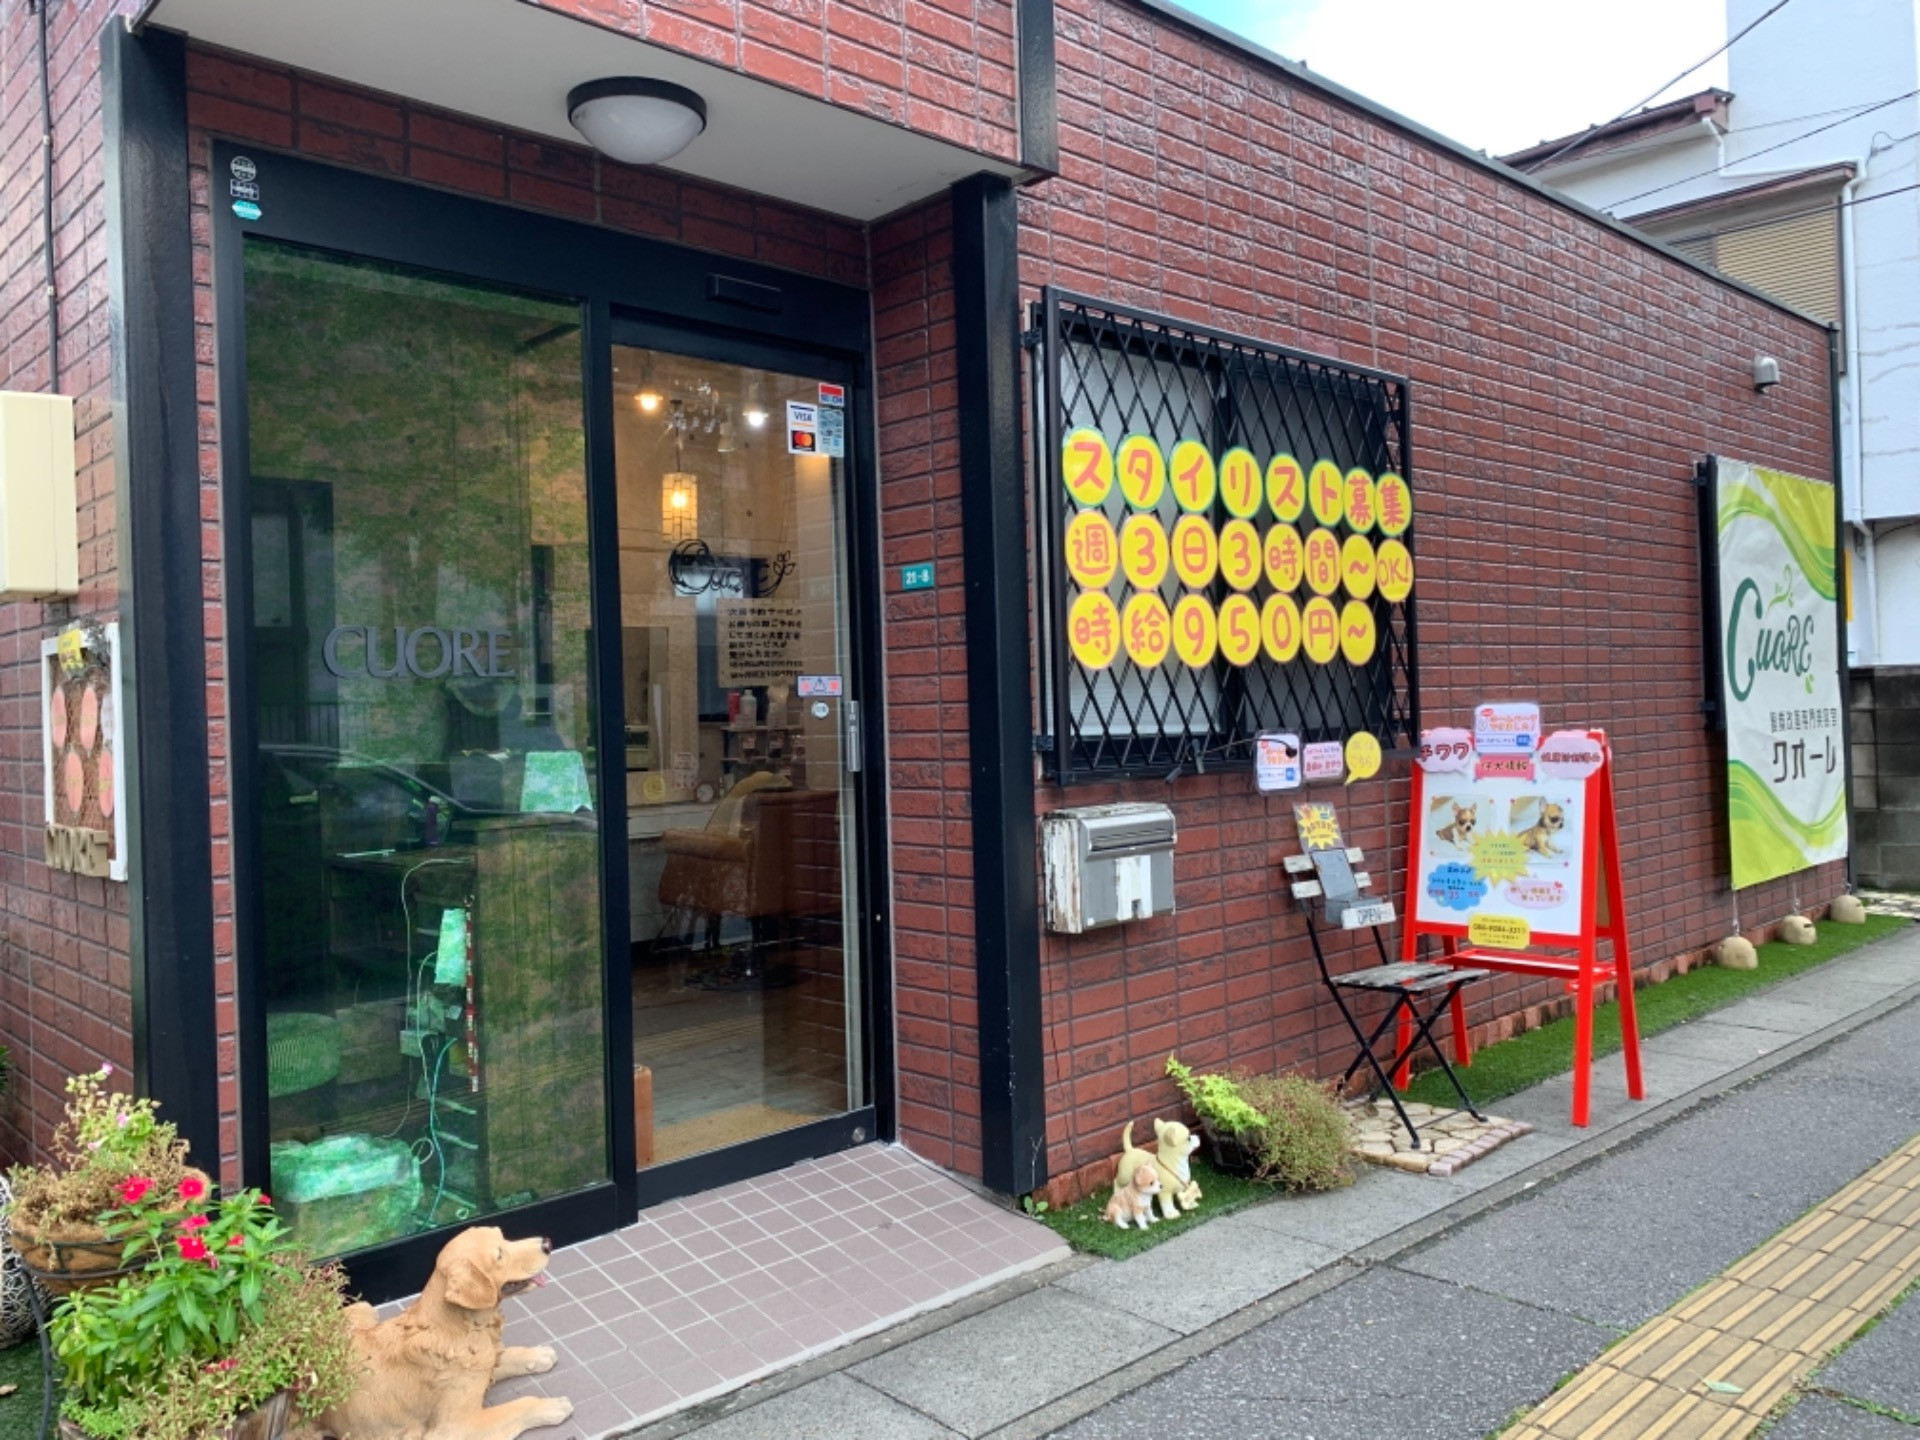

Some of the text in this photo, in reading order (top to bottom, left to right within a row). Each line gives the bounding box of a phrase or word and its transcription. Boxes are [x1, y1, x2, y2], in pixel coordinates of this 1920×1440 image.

[1072, 441, 1405, 528] スタイリスト募集
[322, 624, 515, 678] CUORE
[1772, 735, 1837, 784] クオール
